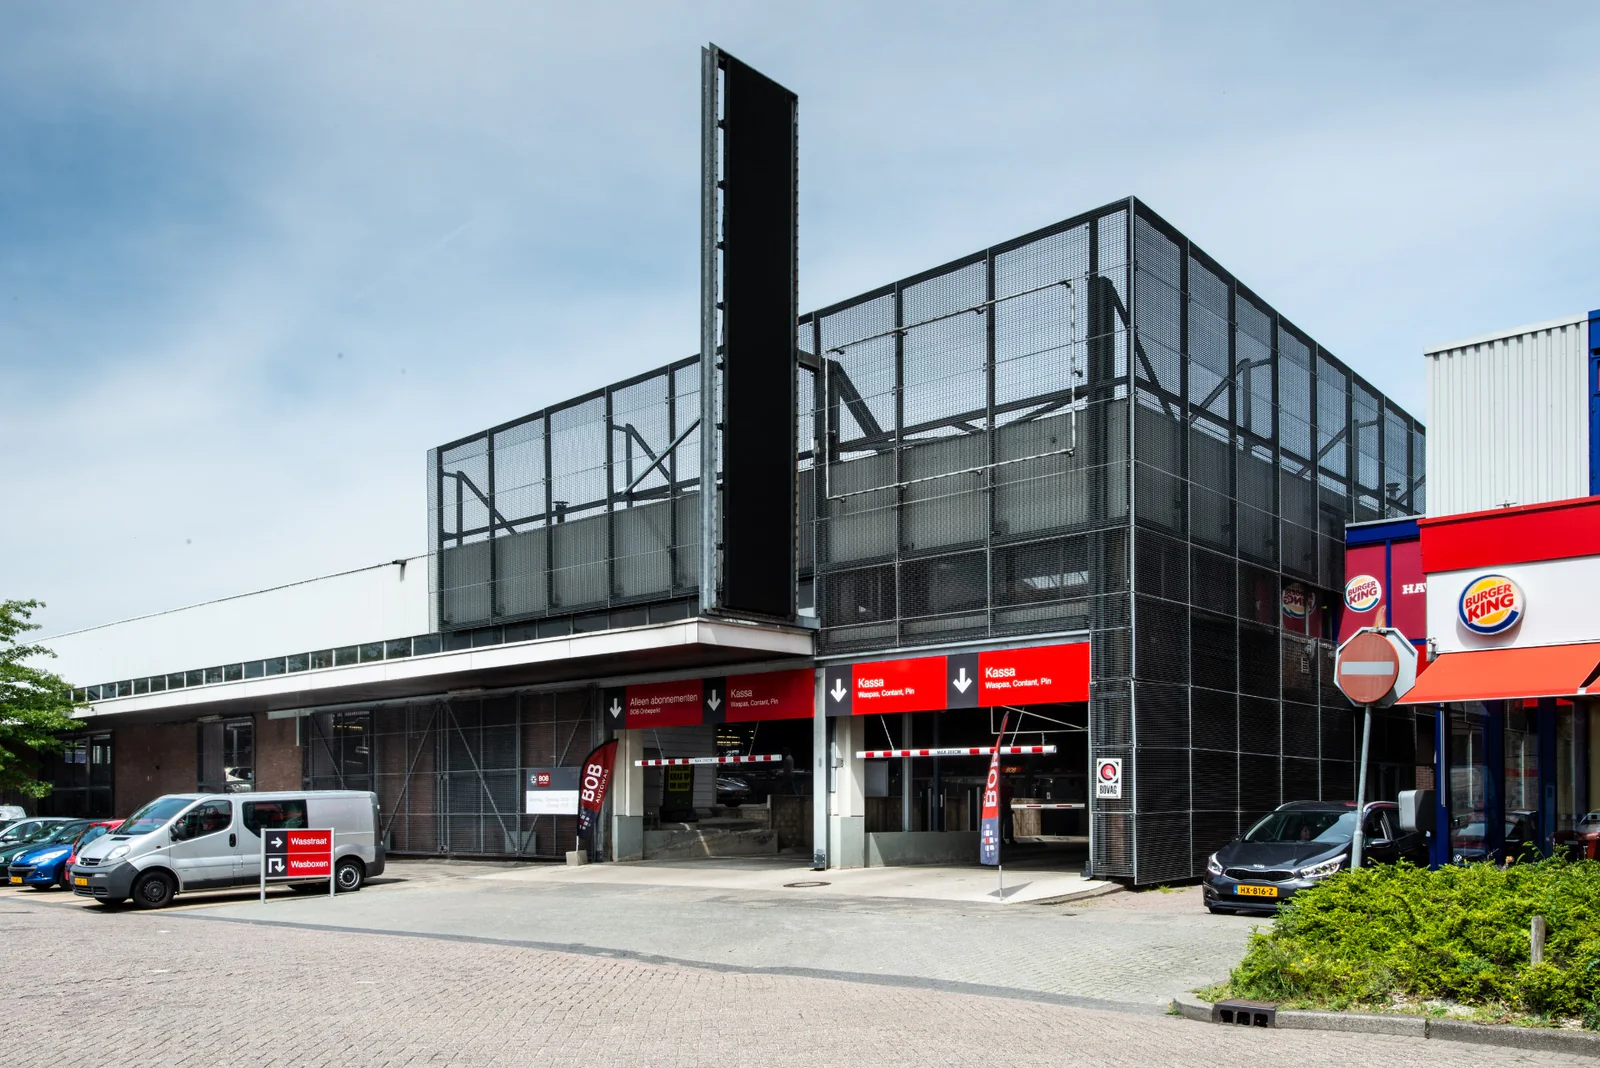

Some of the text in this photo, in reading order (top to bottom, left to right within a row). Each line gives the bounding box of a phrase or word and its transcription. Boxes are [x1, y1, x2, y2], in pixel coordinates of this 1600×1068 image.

[1348, 580, 1376, 597] BURGER
[1349, 587, 1378, 605] KING
[1465, 583, 1511, 609] BURGER
[1467, 593, 1514, 623] KING
[985, 667, 1016, 678] Kassa
[858, 677, 884, 689] Kassa
[985, 677, 1052, 690] Waspas, Contant, Pin
[730, 689, 753, 699] Kassa
[858, 687, 915, 699] Waspas, Contant, Pin
[630, 693, 698, 707] Alleen abonnementen
[770, 697, 779, 705] Pin
[581, 763, 603, 802] BOB
[595, 768, 609, 804] AUTOWAS
[1099, 785, 1118, 795] BOVAG
[291, 837, 327, 845] Wasstraat
[291, 860, 329, 868] Wasboxen
